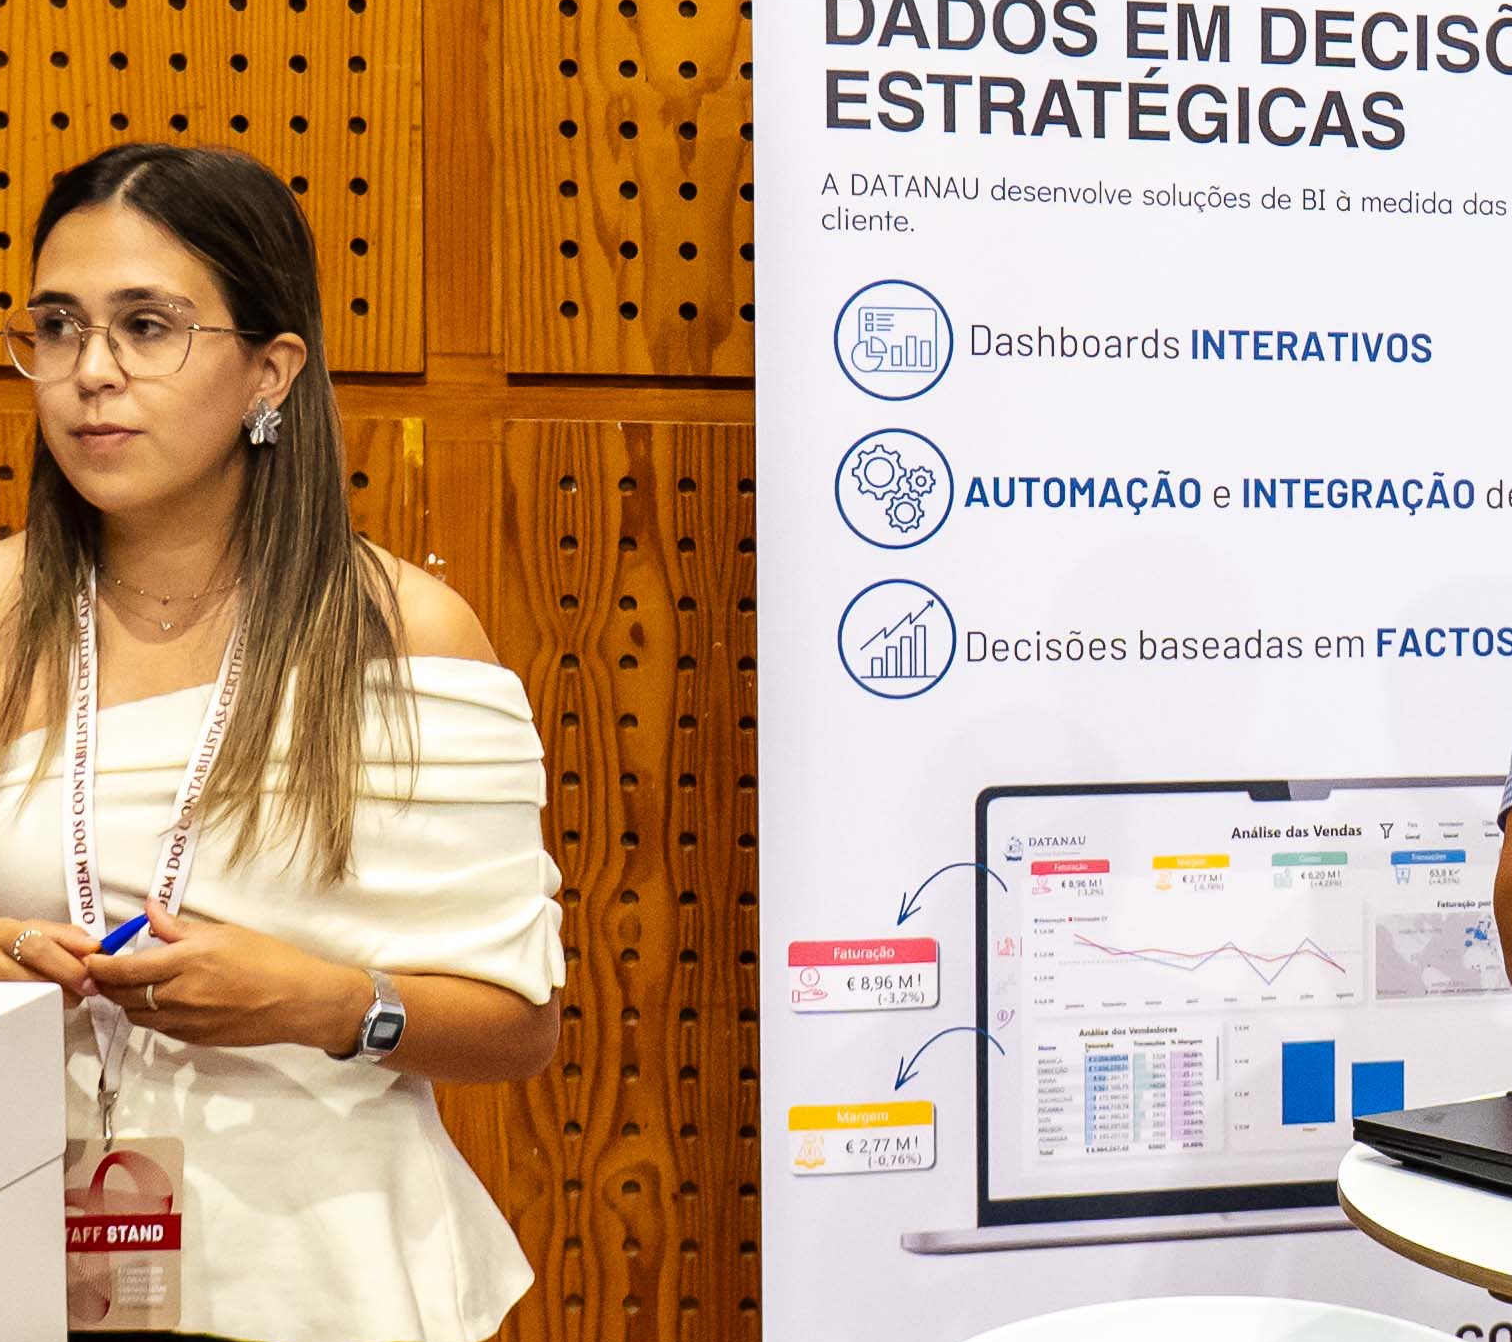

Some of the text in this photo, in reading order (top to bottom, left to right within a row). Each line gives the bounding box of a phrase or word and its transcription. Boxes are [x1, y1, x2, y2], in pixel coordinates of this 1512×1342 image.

[1128, 2, 1231, 63] EM
[827, 64, 1406, 151] ESTRATÉGICAS
[823, 174, 839, 195] A
[853, 175, 979, 200] DATANAU
[992, 178, 1132, 206] desenvolve
[1144, 185, 1251, 213] soluções
[1263, 188, 1292, 210] de
[1304, 190, 1326, 211] BI
[1338, 192, 1351, 212] à
[1363, 192, 1452, 215] medida
[1462, 195, 1508, 217] das
[823, 208, 915, 232] cliente.
[973, 326, 1432, 364] Dashboards INTERATIVOS
[965, 471, 1201, 516] AUTOMAÇÃO
[1215, 487, 1231, 509] e
[1245, 473, 1475, 517] INTEGRAÇÃO
[969, 632, 1127, 663] Decisões
[1141, 630, 1303, 661] baseadas
[1316, 637, 1364, 659] em
[72, 694, 88, 815] CONTABILISTAS
[73, 817, 88, 854] DOS
[1028, 835, 1087, 847] DATANAU
[1231, 824, 1362, 840] Análise das Vendas
[167, 833, 187, 869] DOS
[74, 861, 95, 925] ORDEM
[833, 947, 895, 961] Faturação
[847, 977, 855, 991] €
[861, 975, 893, 992] 8,96
[877, 991, 925, 1006] (-3,2%)
[1079, 1025, 1177, 1037] Análise dos Vendedores
[837, 1109, 888, 1126] Margem
[846, 1140, 854, 1154] €
[859, 1138, 889, 1154] 2,77
[868, 1154, 922, 1169] (-0,76%)
[106, 1224, 164, 1243] STAND
